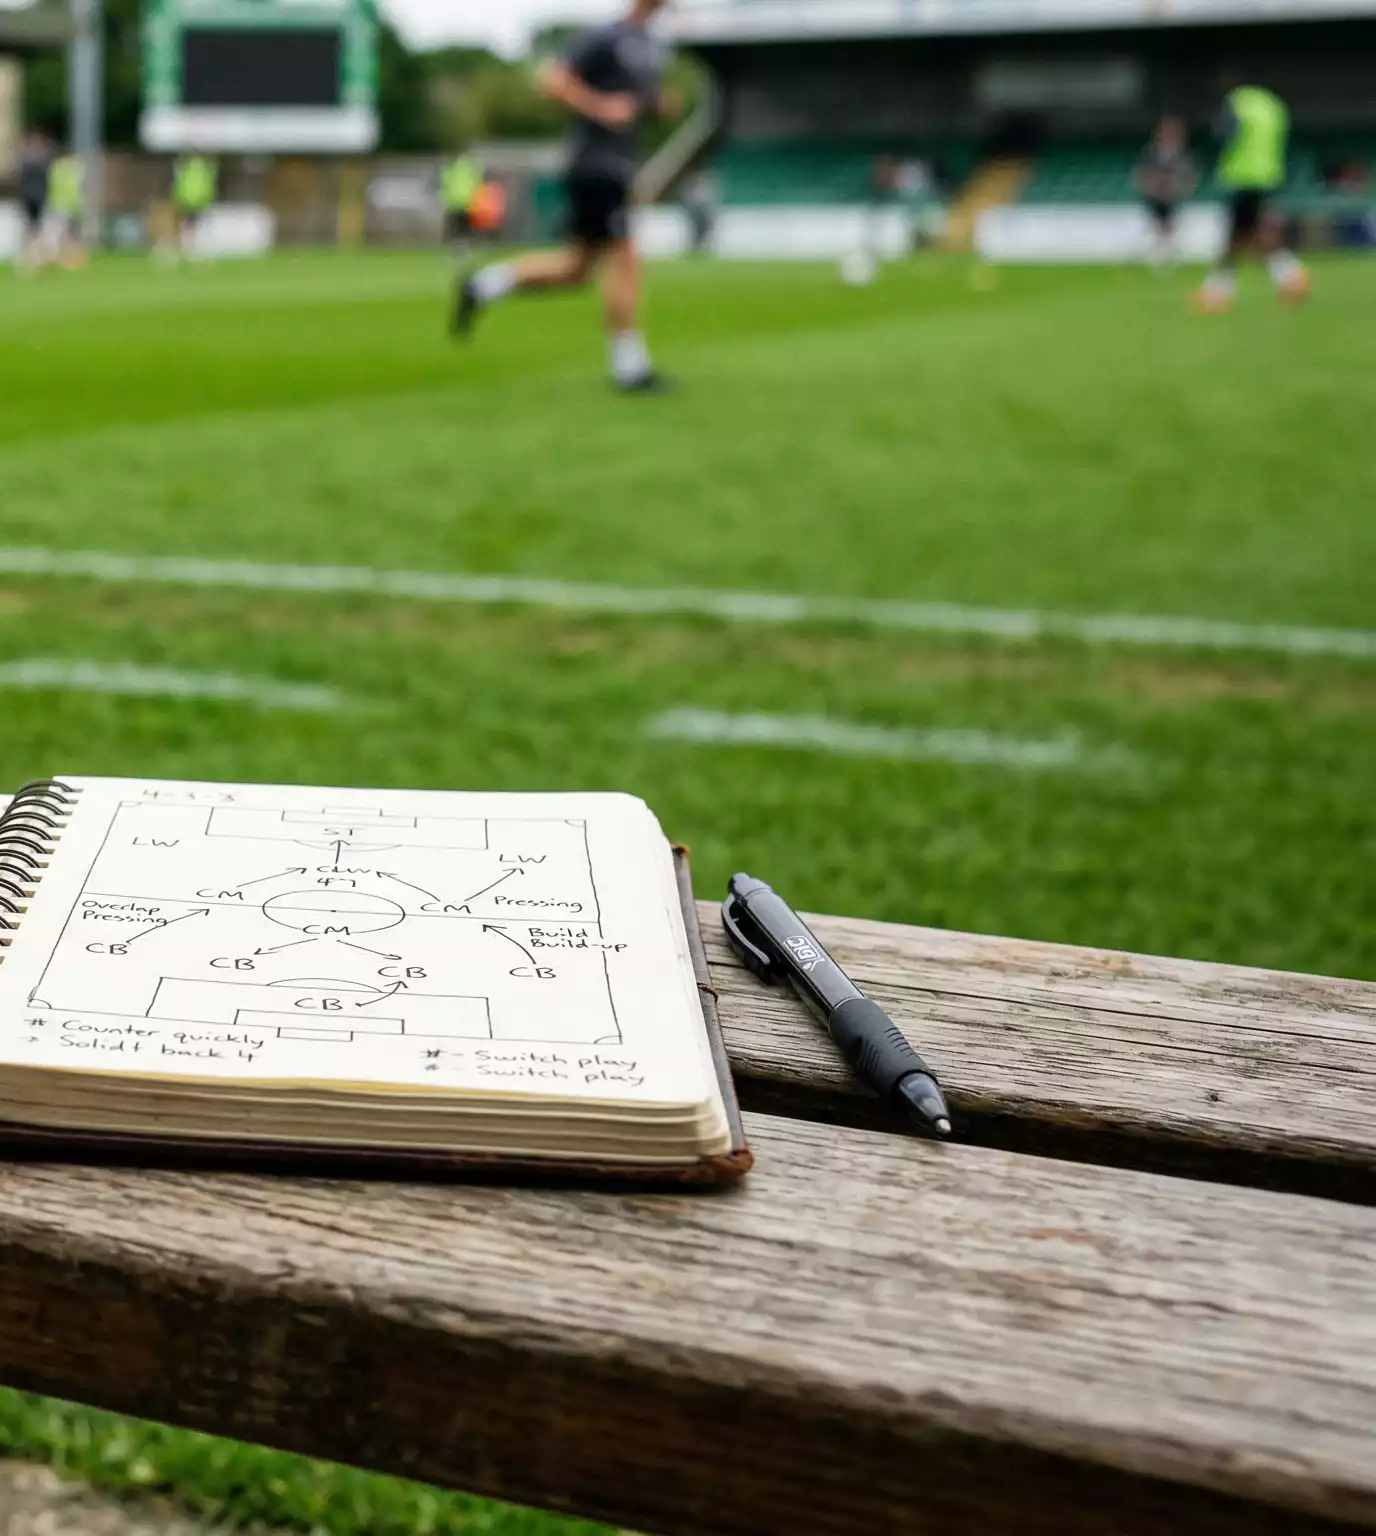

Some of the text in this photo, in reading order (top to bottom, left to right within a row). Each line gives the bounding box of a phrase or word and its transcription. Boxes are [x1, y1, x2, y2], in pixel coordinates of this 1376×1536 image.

[131, 836, 180, 848] LW
[499, 853, 547, 864] LW
[195, 888, 245, 901] CM
[81, 900, 161, 916] Overlap
[420, 902, 472, 915] CM
[494, 895, 584, 914] Pressing
[82, 910, 168, 927] Pressing
[302, 924, 351, 936] CM
[528, 927, 589, 938] Build
[85, 942, 129, 956] CB
[530, 938, 628, 953] Build-up
[209, 957, 256, 971] CB
[377, 966, 427, 979] CB
[508, 966, 557, 979] CB
[294, 997, 343, 1011] CB
[61, 1019, 160, 1038] Counter
[172, 1030, 265, 1050] quickly
[160, 1043, 226, 1060] back
[238, 1049, 256, 1063] 4
[474, 1049, 568, 1065] Switch
[578, 1053, 638, 1073] play
[476, 1064, 569, 1080] Switch
[584, 1069, 645, 1087] play
